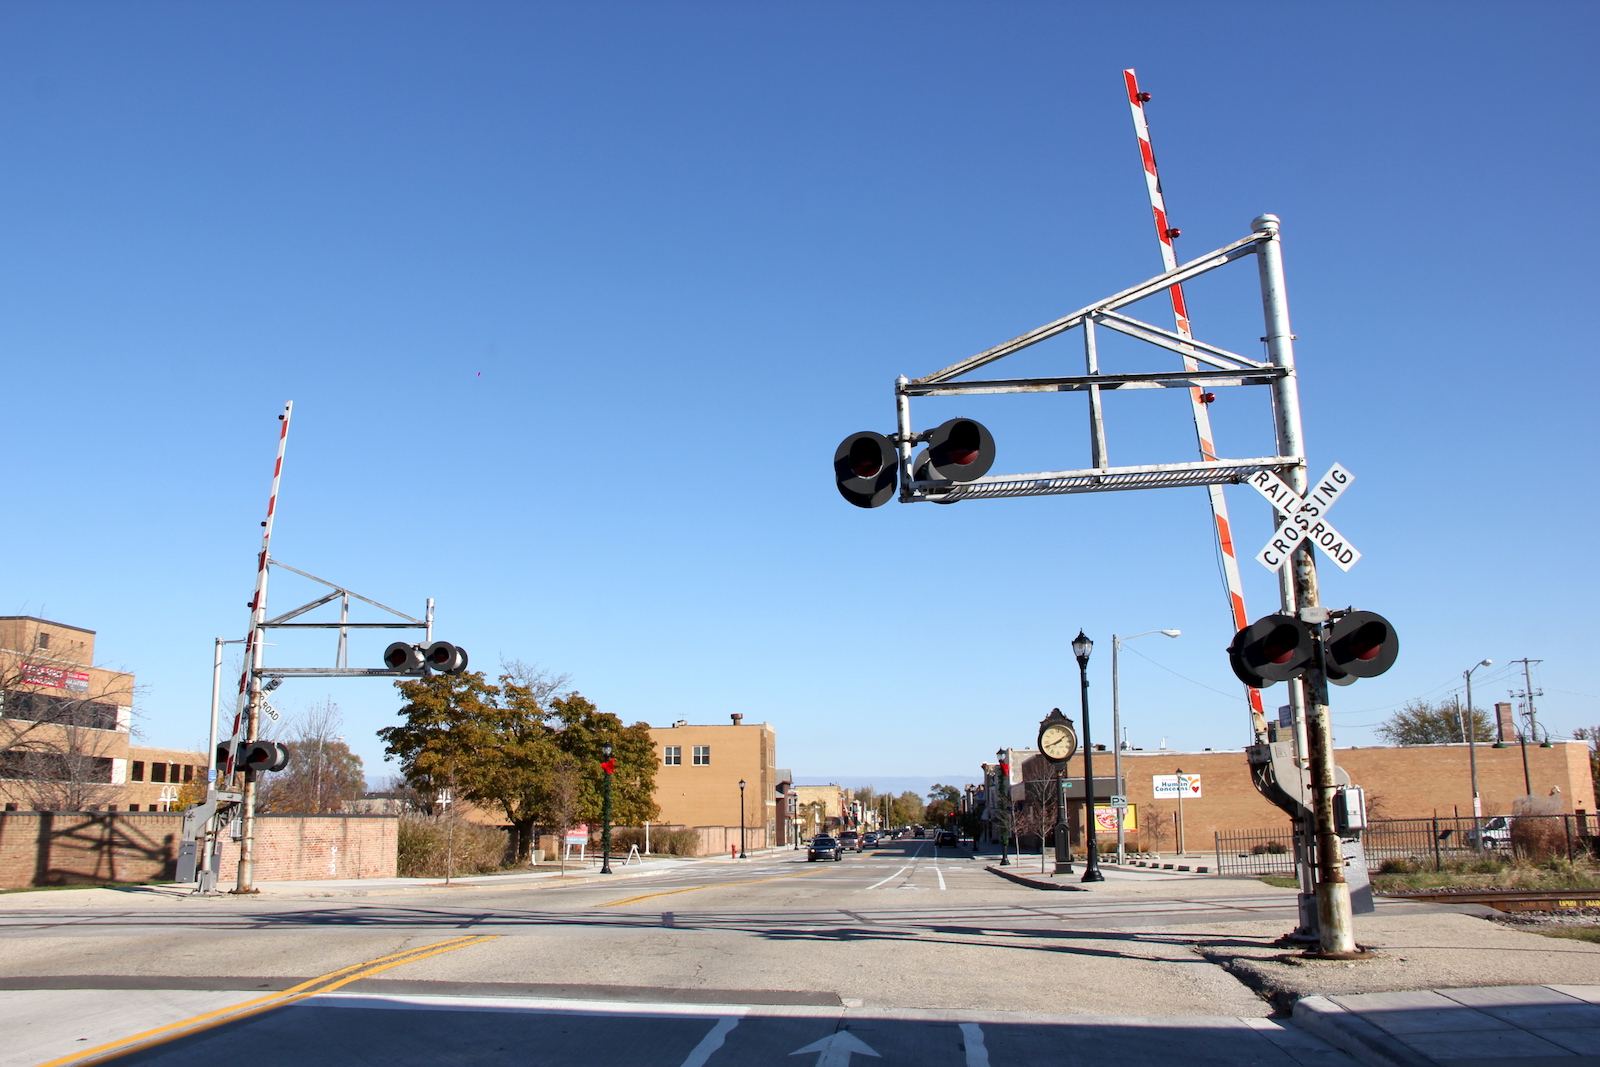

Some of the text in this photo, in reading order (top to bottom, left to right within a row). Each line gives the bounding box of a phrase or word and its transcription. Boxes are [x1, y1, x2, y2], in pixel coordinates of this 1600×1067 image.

[1254, 471, 1353, 564] RAIL ROAD
[1264, 470, 1347, 566] CROSSING
[262, 701, 279, 721] ROAD
